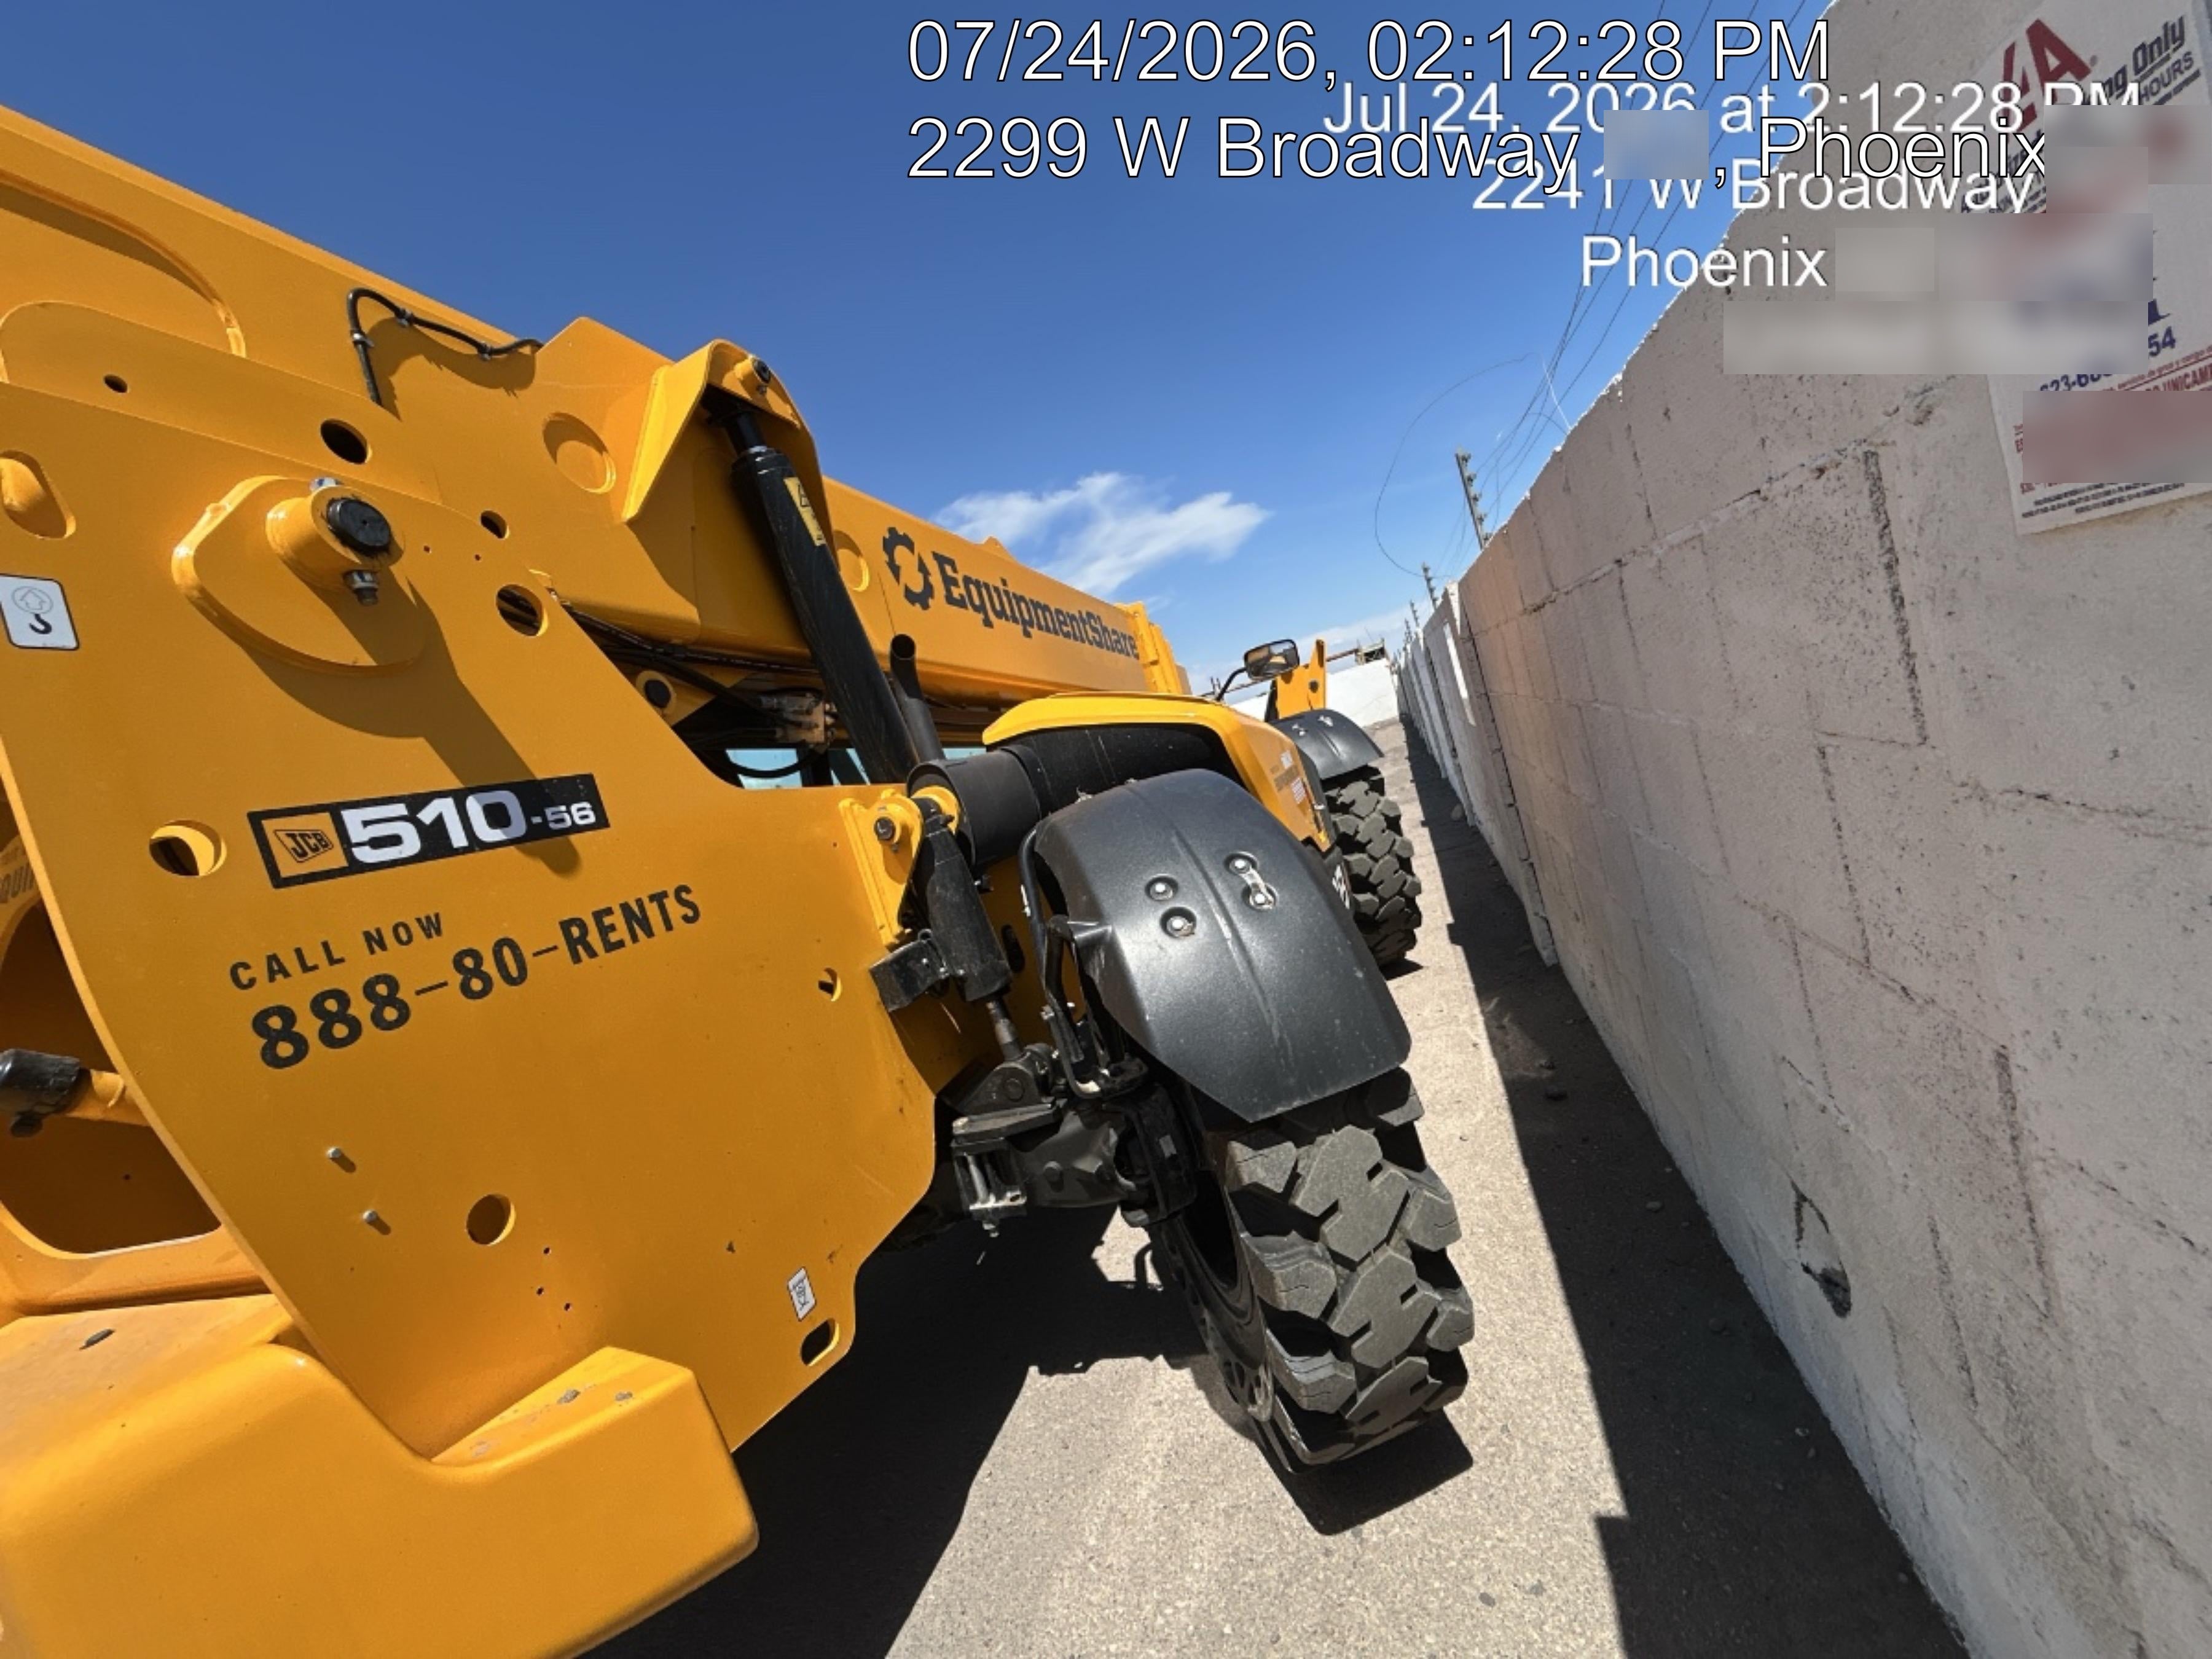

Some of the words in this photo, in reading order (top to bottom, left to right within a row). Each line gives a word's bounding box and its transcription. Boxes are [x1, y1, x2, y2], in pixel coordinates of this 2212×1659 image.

[2132, 15, 2186, 76] Only
[931, 551, 1140, 661] EquipmentShare
[283, 831, 331, 859] JCB
[340, 790, 597, 865] 510-56
[229, 939, 345, 990] CALL
[363, 912, 444, 955] NOW
[251, 884, 702, 1070] 888-80-RENTS
